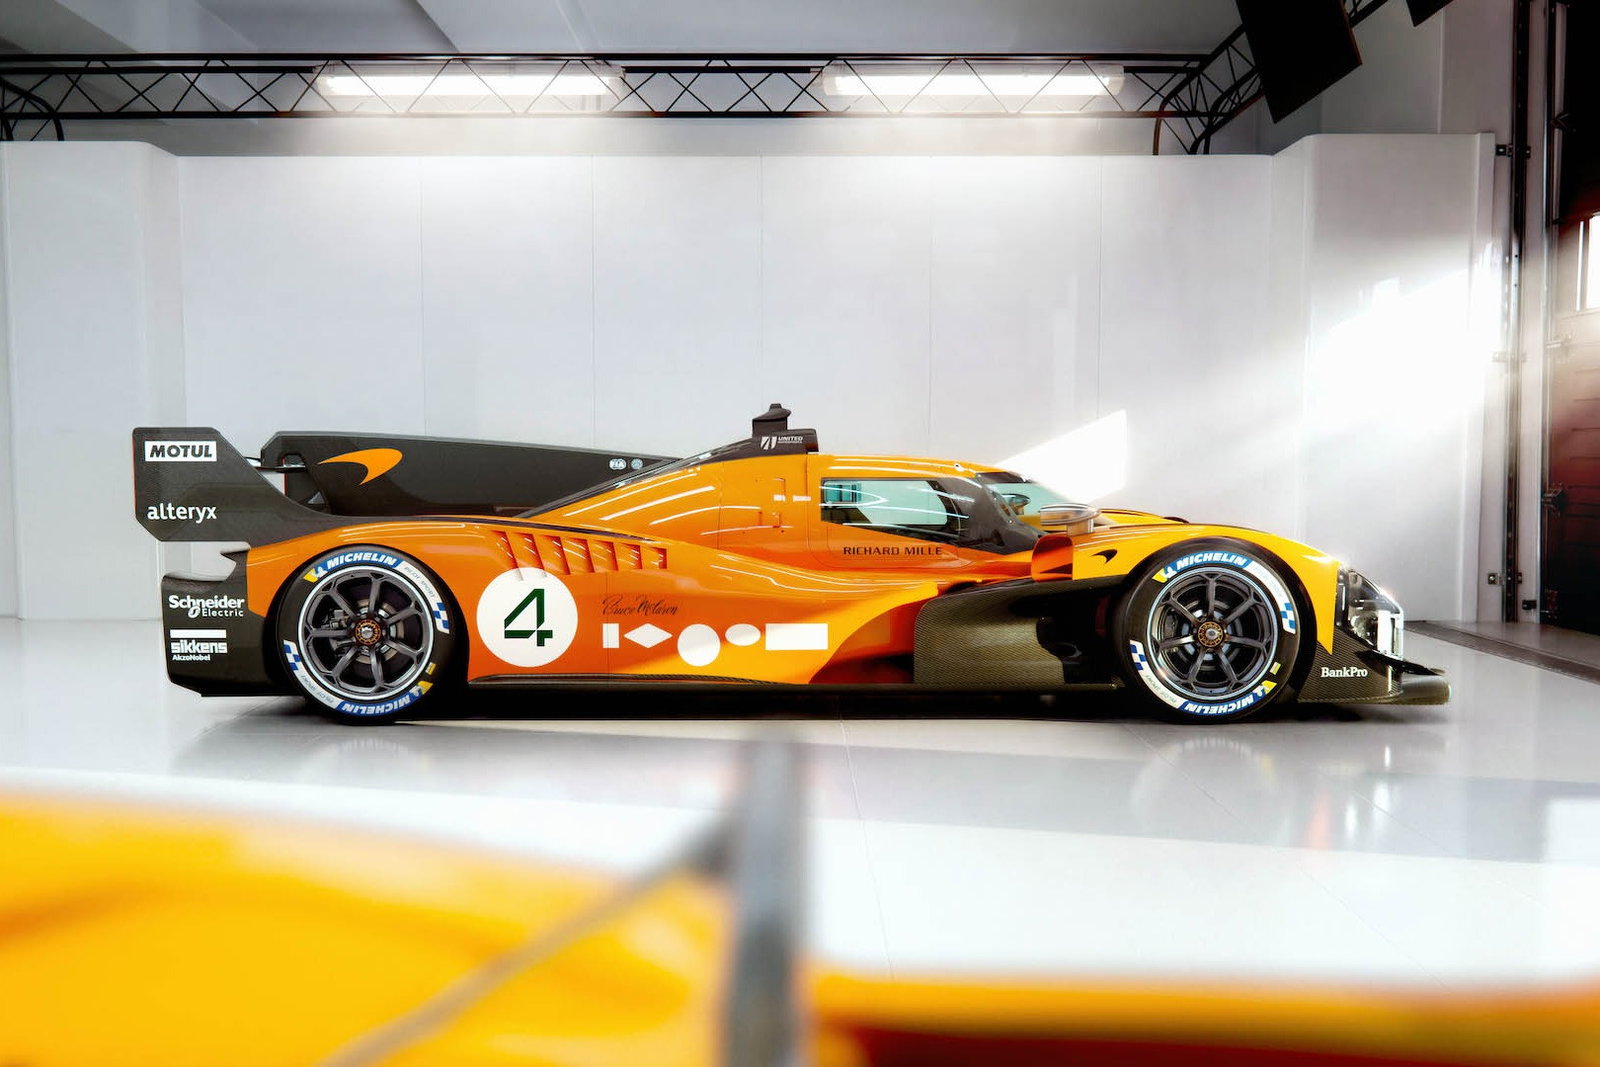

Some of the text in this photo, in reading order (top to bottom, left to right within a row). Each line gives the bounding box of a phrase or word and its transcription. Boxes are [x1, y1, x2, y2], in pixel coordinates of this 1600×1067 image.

[149, 444, 213, 458] MOTUL
[147, 502, 217, 524] alteryx
[843, 546, 943, 555] RICHARD MILLE
[326, 552, 397, 569] MICHELIN
[1176, 552, 1247, 571] MICHELIN
[168, 595, 245, 609] Schneider
[202, 608, 244, 617] Electric
[504, 588, 553, 647] 4
[171, 640, 228, 654] sikkens
[1321, 666, 1368, 678] BankPro
[341, 694, 411, 715] MICHELIN
[1184, 695, 1254, 714] MICHELIN
